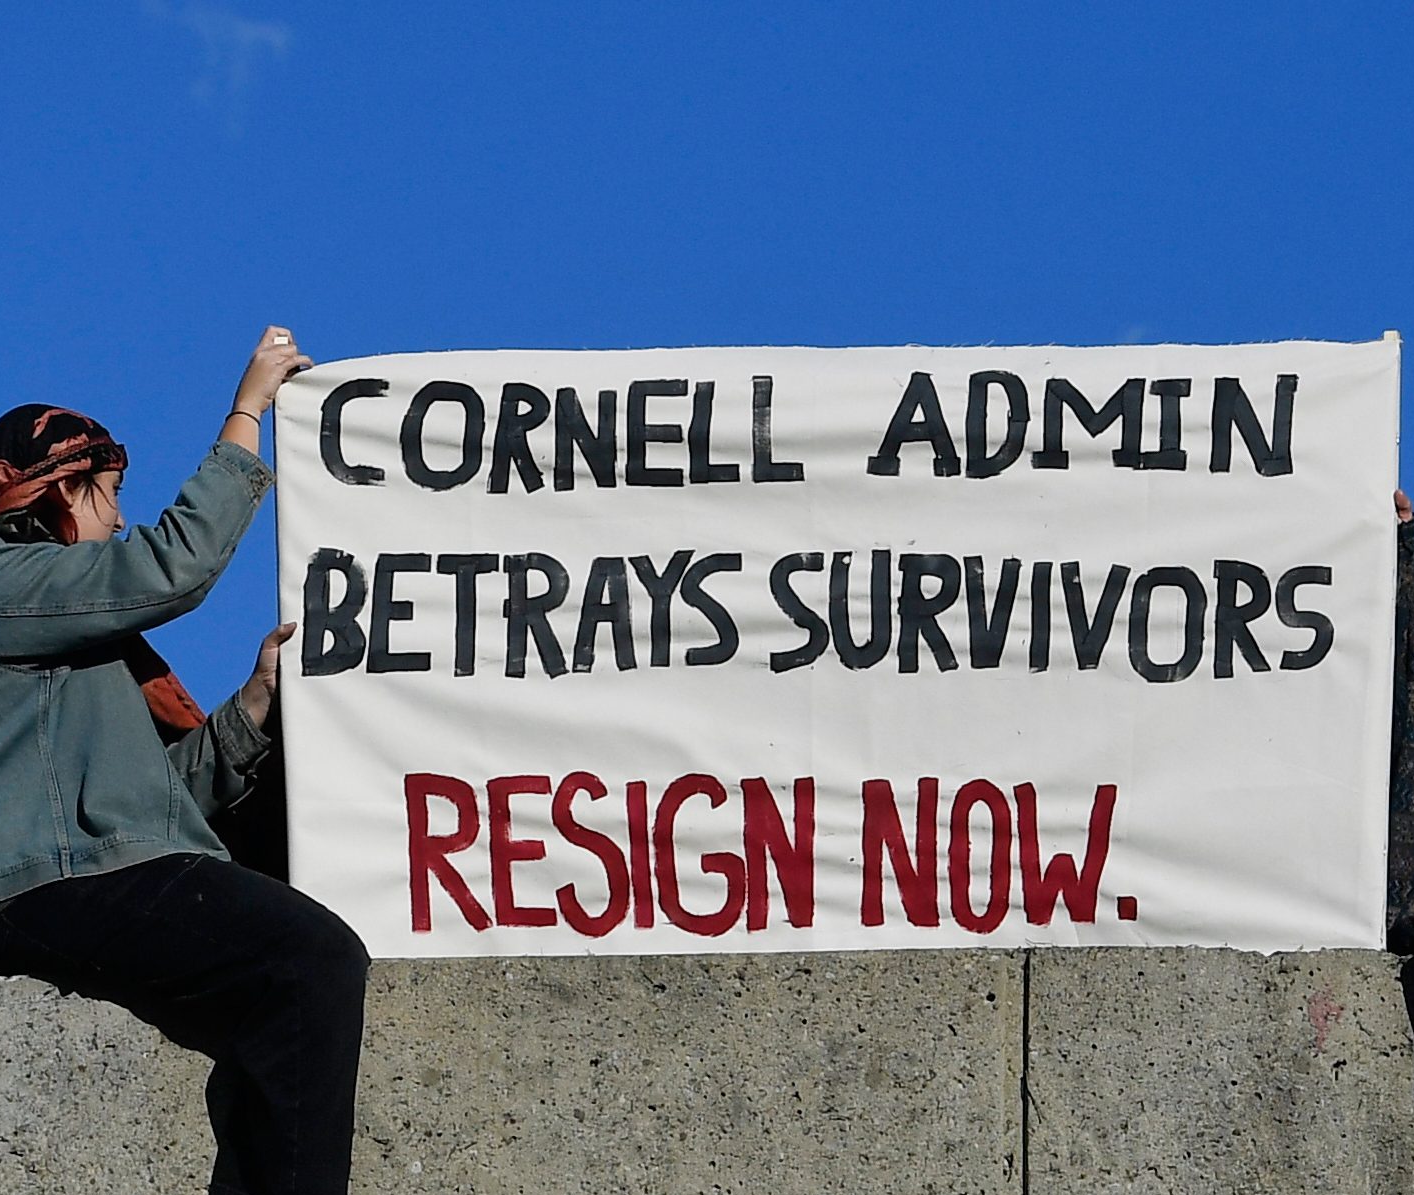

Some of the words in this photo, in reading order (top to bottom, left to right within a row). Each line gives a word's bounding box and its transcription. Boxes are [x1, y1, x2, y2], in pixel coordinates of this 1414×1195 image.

[319, 373, 804, 495] CORNELL
[866, 369, 1299, 479] ADMIN
[301, 546, 742, 679] BETRAYS
[769, 548, 1334, 684] SURVIVORS
[403, 771, 816, 937] RESIGN
[860, 775, 1138, 935] NOW.
